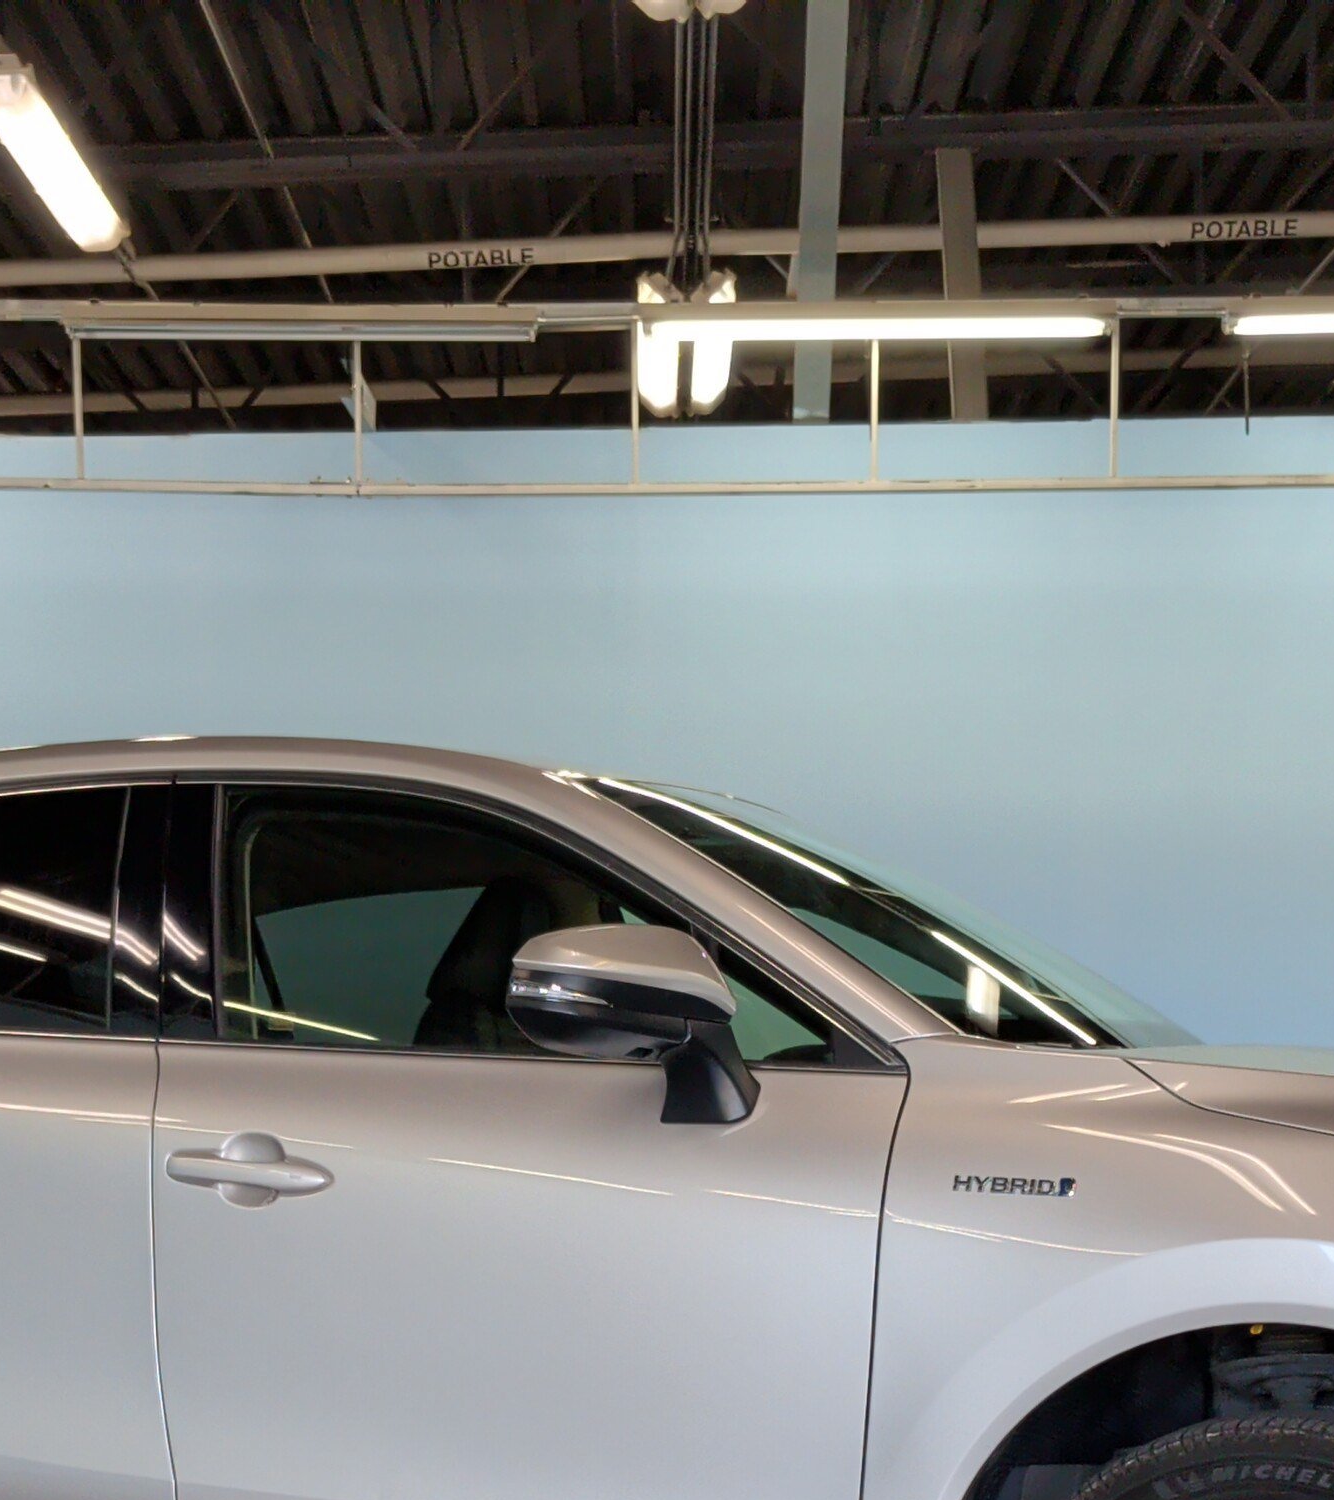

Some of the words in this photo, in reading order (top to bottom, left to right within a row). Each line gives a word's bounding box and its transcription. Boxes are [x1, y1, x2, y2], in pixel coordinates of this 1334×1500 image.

[1190, 219, 1298, 239] POTABLE
[428, 247, 534, 268] POTABLE
[952, 1174, 1056, 1196] HYBRID
